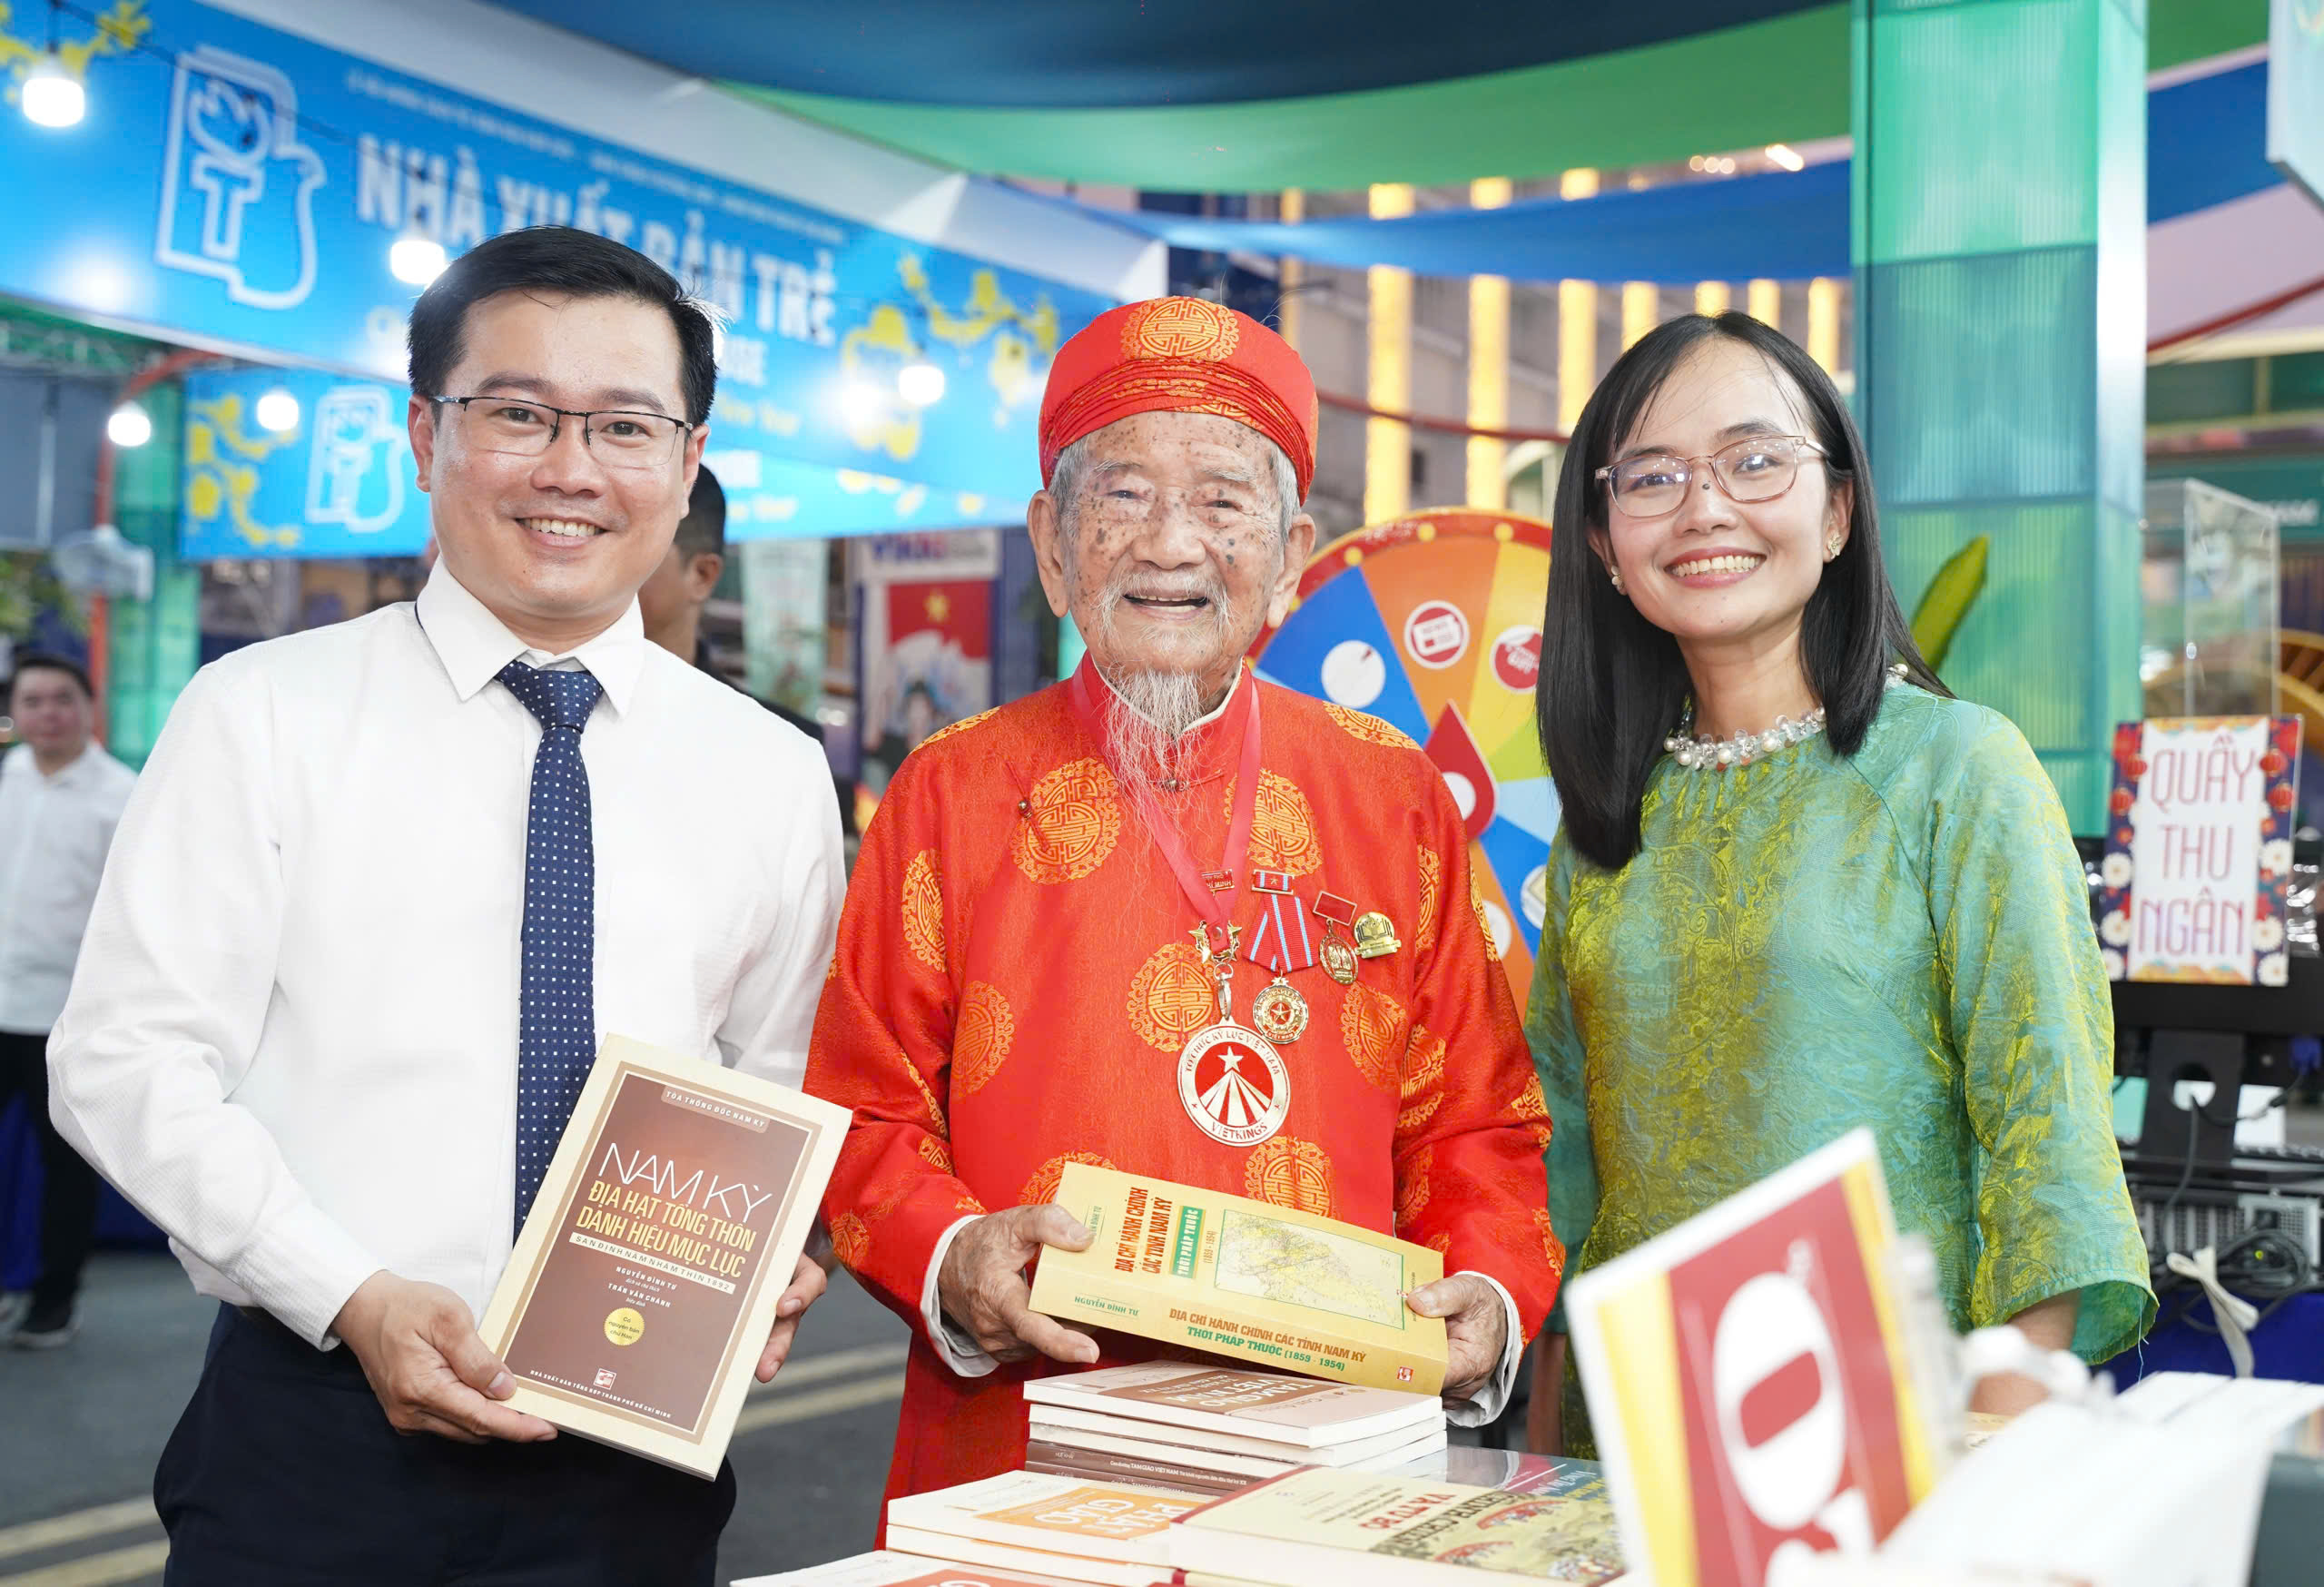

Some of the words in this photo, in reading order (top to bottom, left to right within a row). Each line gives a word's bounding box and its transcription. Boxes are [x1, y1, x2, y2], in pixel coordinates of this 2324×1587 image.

[2160, 823, 2234, 882] THU
[2137, 886, 2246, 956] NGÂN
[733, 1112, 752, 1123] NAM
[1211, 1120, 1268, 1140] VIETKINGS
[597, 1142, 704, 1206] NAM
[702, 1174, 773, 1224] KỲ
[1124, 1187, 1148, 1217] CHÍNH
[1150, 1196, 1173, 1212] KỲ
[587, 1179, 622, 1208] ĐỊA
[621, 1189, 662, 1220] HẠT
[661, 1200, 709, 1236] TỔNG
[708, 1217, 757, 1252] THÔN
[1148, 1211, 1170, 1236] NAM
[1183, 1209, 1200, 1236] THUỘC
[576, 1205, 628, 1239] DANH
[626, 1220, 670, 1252] HIỆU
[666, 1233, 711, 1267] MỤC
[709, 1247, 746, 1278] LỤC
[1118, 1216, 1143, 1244] HÀNH
[1115, 1242, 1137, 1258] CHÍ
[1179, 1236, 1195, 1257] PHÁP
[575, 1235, 596, 1248] SAN
[705, 1276, 730, 1291] 1892
[1114, 1257, 1138, 1273] ĐỊA
[1138, 1257, 1163, 1274] CÁC
[1177, 1257, 1191, 1276] THỜI
[615, 1266, 646, 1280] NGUYỄN
[646, 1276, 665, 1287] ĐÌNH
[666, 1281, 677, 1291] TƯ
[645, 1295, 672, 1308] CHÁNH
[1074, 1296, 1105, 1309] NGUYỄN
[1107, 1303, 1127, 1314] ĐÌNH
[1168, 1308, 1187, 1322] ĐỊA
[1189, 1312, 1208, 1326] CHÍ
[1208, 1317, 1239, 1334] HÀNH
[1240, 1324, 1273, 1341] CHÍNH
[1275, 1331, 1296, 1346] CÁC
[1323, 1343, 1350, 1360] NAM
[1350, 1351, 1367, 1363] KỲ
[1187, 1326, 1213, 1341] THỜI
[1214, 1332, 1245, 1347] PHÁP
[1247, 1340, 1283, 1357] THUỘC
[1284, 1350, 1311, 1363] (1859
[1319, 1357, 1345, 1372] 1954)
[655, 1409, 672, 1419] MINH
[1130, 1462, 1142, 1470] TAM
